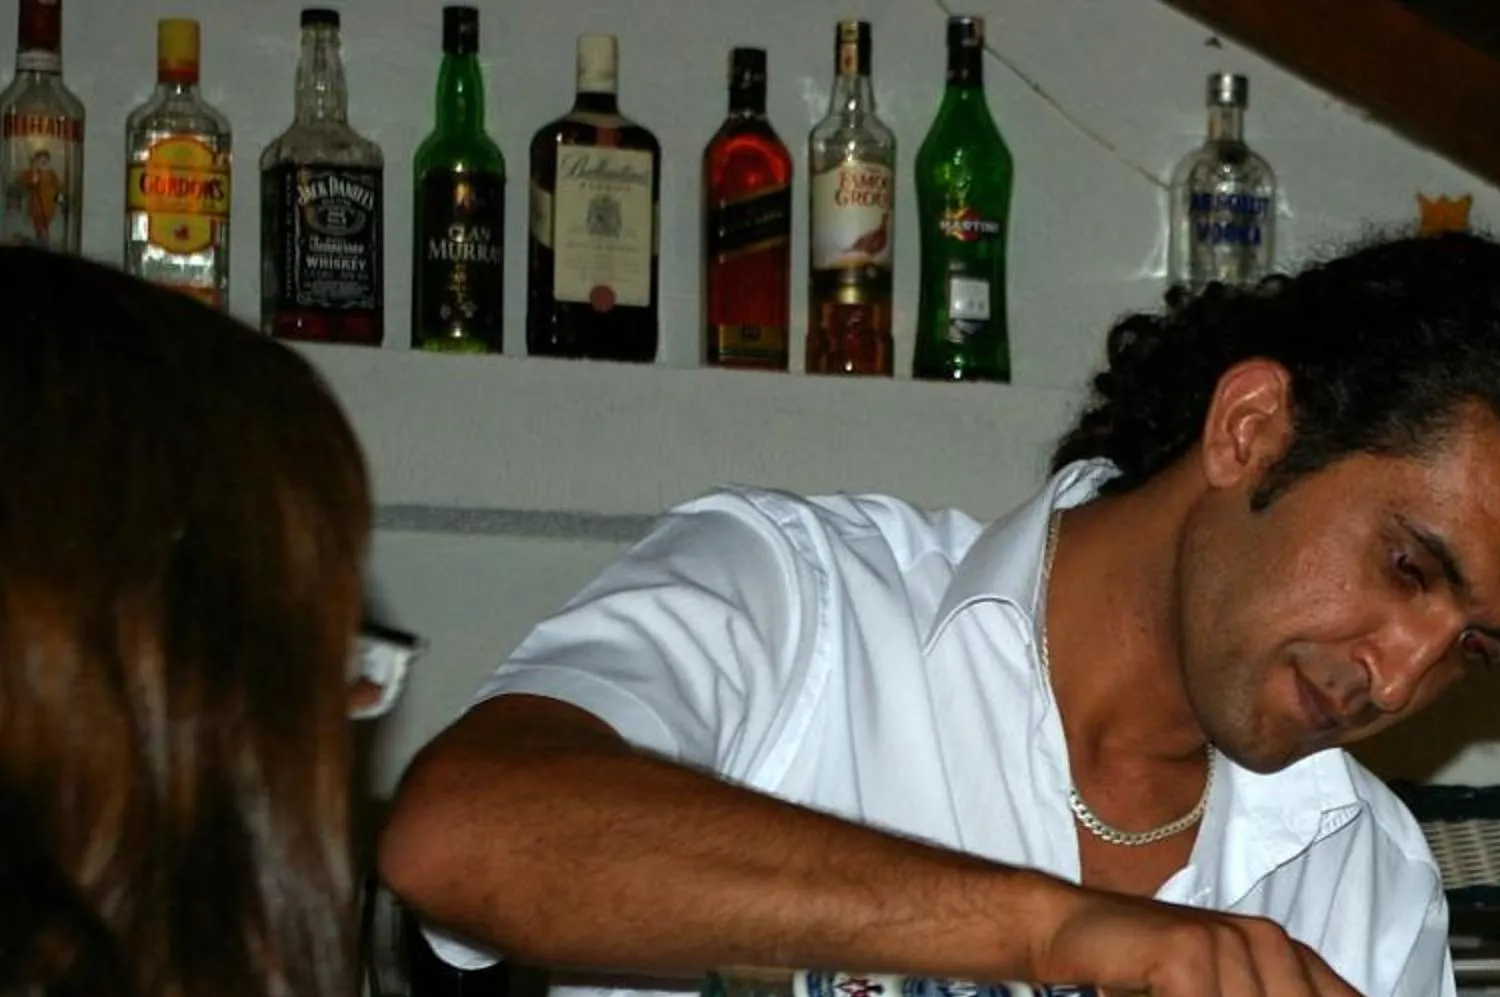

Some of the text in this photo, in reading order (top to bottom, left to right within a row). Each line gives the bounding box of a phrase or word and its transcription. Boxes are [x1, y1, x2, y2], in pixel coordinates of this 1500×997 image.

[297, 178, 327, 205] JACK
[939, 220, 1000, 234] MARTINI
[305, 255, 367, 271] WHISKEY
